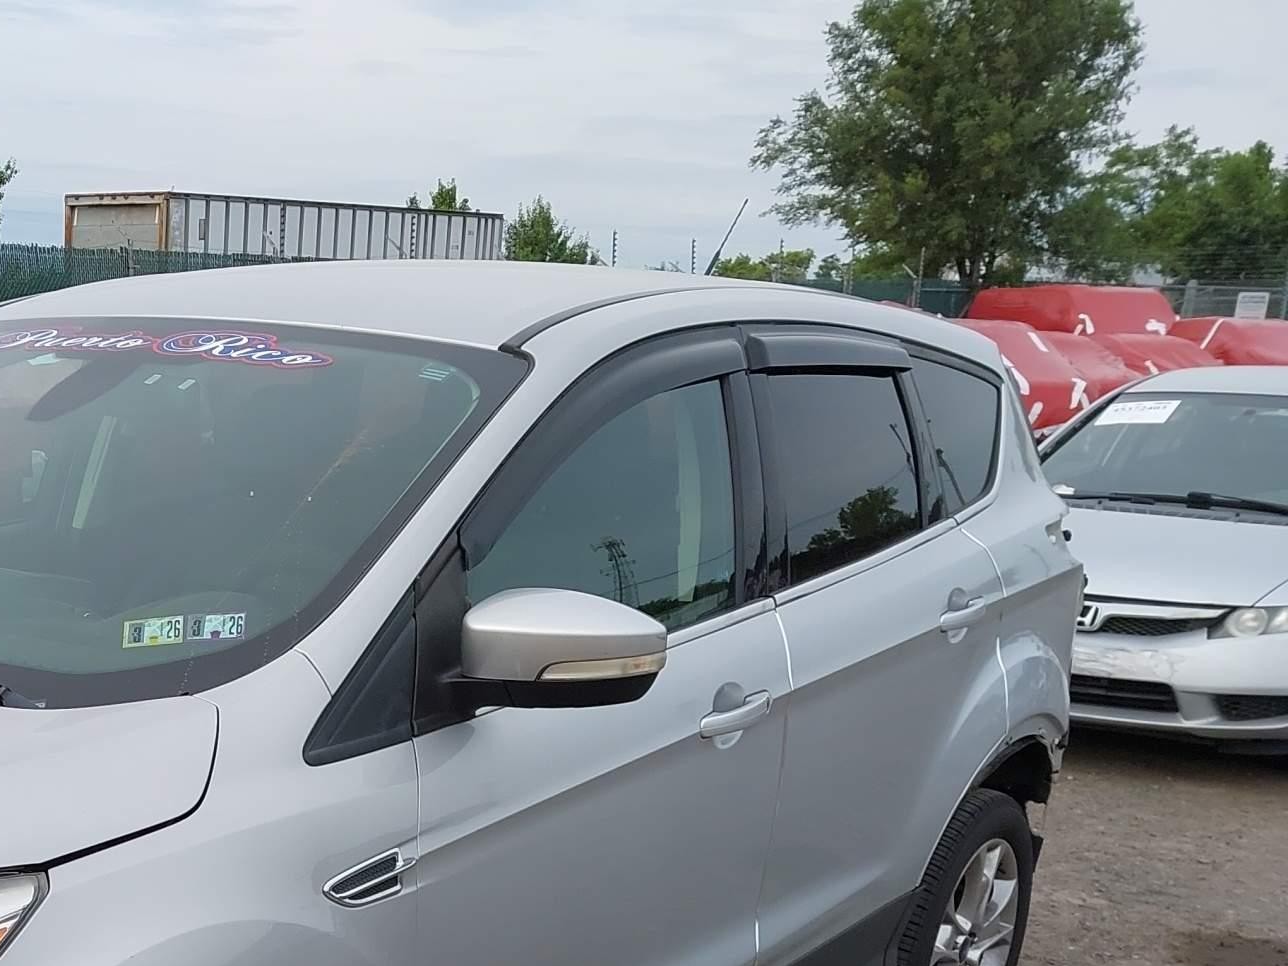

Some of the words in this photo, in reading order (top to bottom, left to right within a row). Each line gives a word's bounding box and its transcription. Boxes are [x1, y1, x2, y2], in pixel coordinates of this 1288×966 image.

[161, 332, 323, 365] Rico
[132, 626, 142, 643] 3
[167, 619, 181, 639] 26
[192, 619, 202, 637] 3
[229, 615, 243, 635] 26
